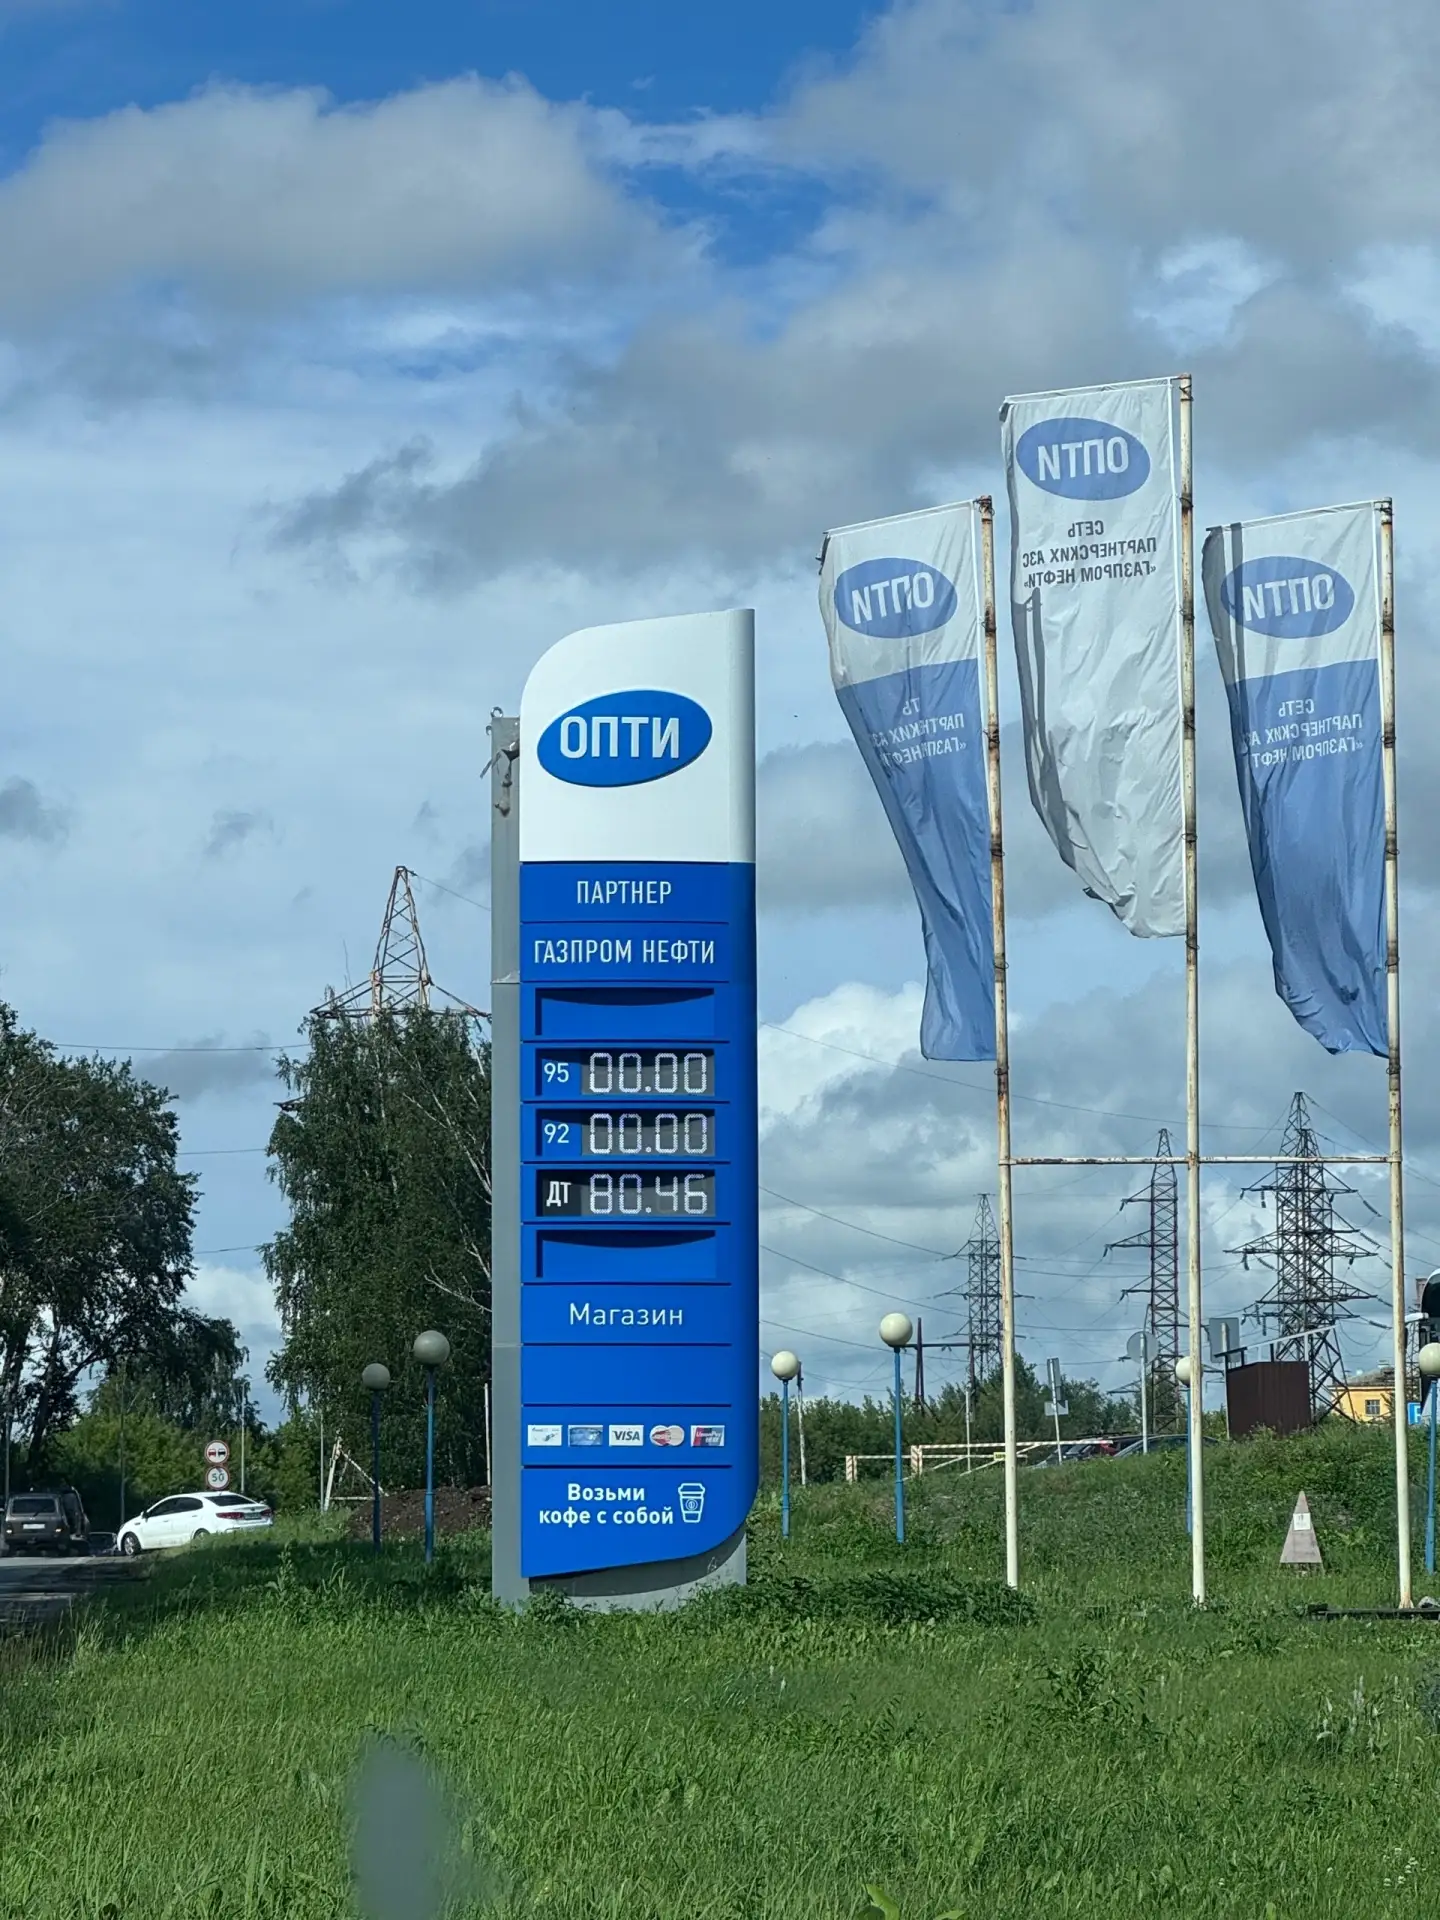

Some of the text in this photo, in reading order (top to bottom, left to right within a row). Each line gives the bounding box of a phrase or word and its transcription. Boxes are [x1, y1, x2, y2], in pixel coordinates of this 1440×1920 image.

[560, 716, 680, 759] ОПТИ
[576, 880, 672, 905] ПАРТНЕР
[534, 939, 715, 965] ГАЗПРОМ НЕФТИ
[543, 1052, 707, 1094] 95 00.00
[543, 1112, 708, 1154] 92 00.00
[546, 1172, 708, 1215] ДТ 80.46
[569, 1302, 683, 1327] Магазин
[612, 1430, 641, 1441] VISA
[211, 1473, 225, 1482] 50
[567, 1483, 645, 1502] Возьми
[539, 1505, 674, 1528] кофе с собой
